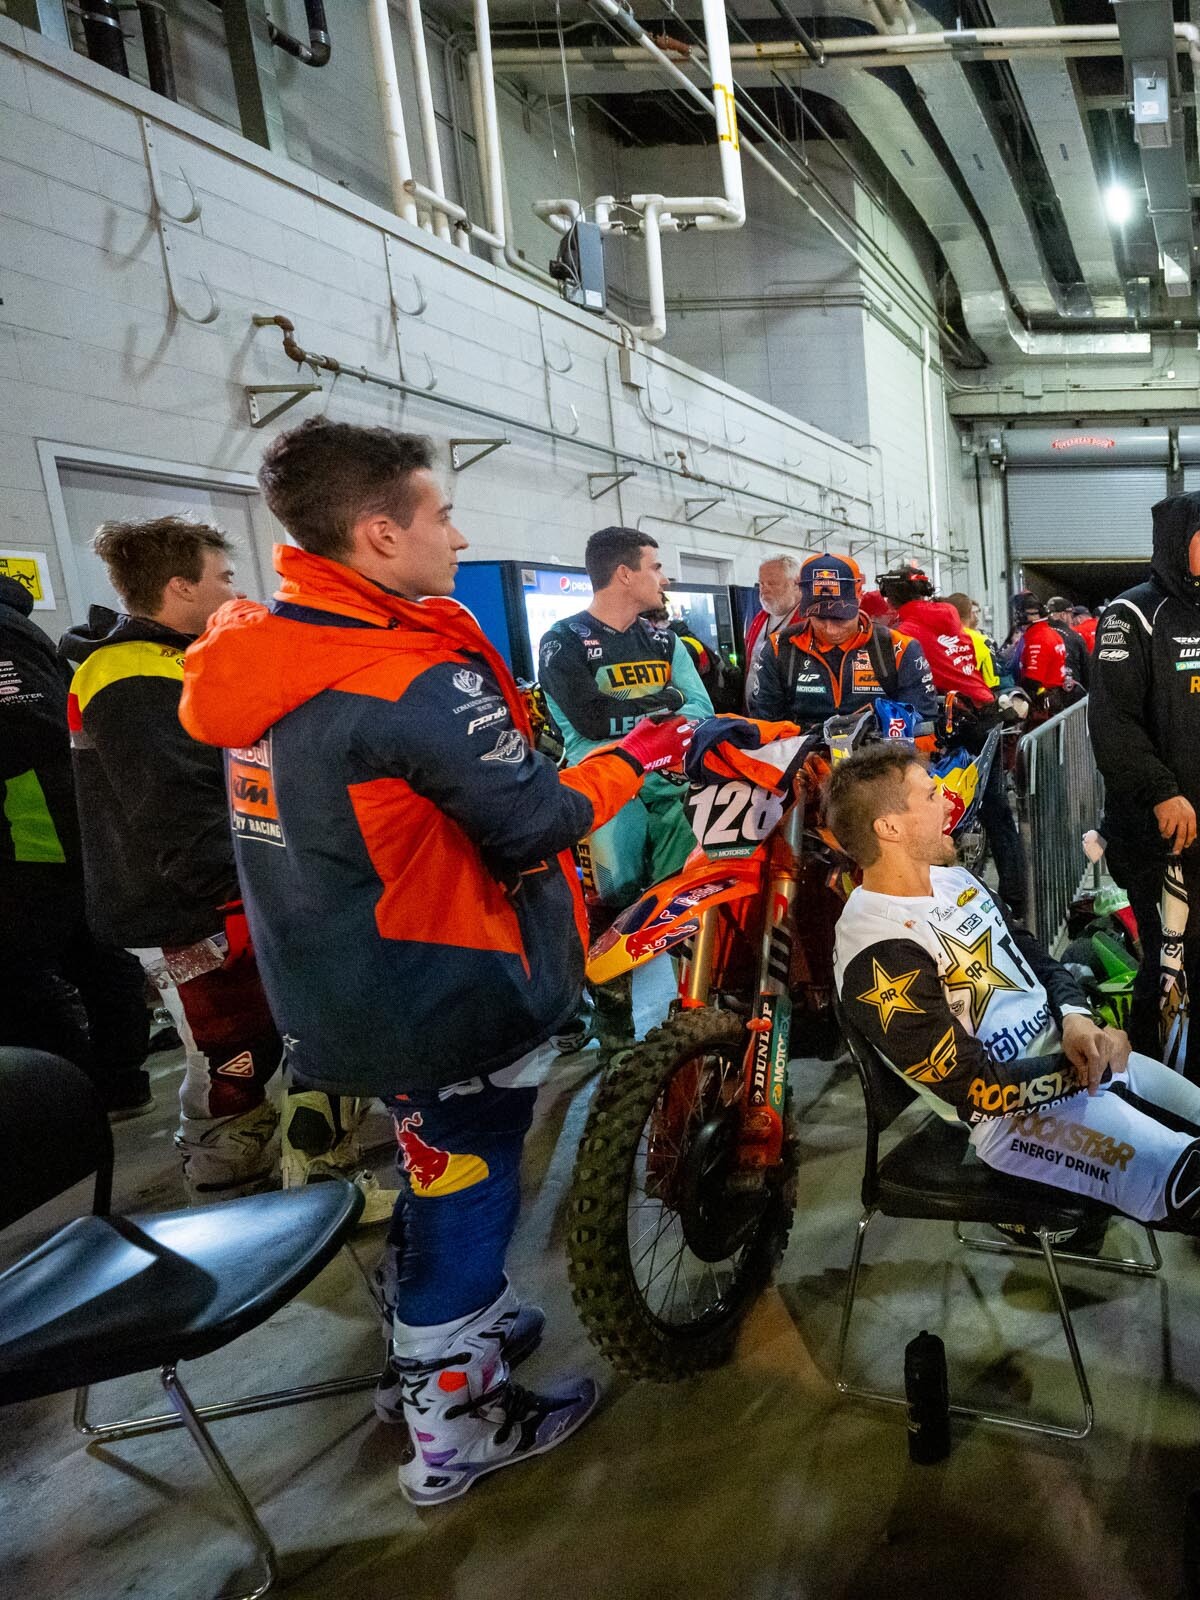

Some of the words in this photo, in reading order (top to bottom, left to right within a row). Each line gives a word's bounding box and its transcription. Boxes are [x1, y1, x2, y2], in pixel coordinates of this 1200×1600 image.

[606, 663, 666, 688] LEATT
[248, 818, 281, 838] RACING
[688, 779, 783, 846] 128
[577, 843, 598, 898] EATT
[718, 848, 750, 858] MOTOREX
[1010, 1138, 1064, 1165] ENERGY
[1064, 1155, 1111, 1184] DRINK
